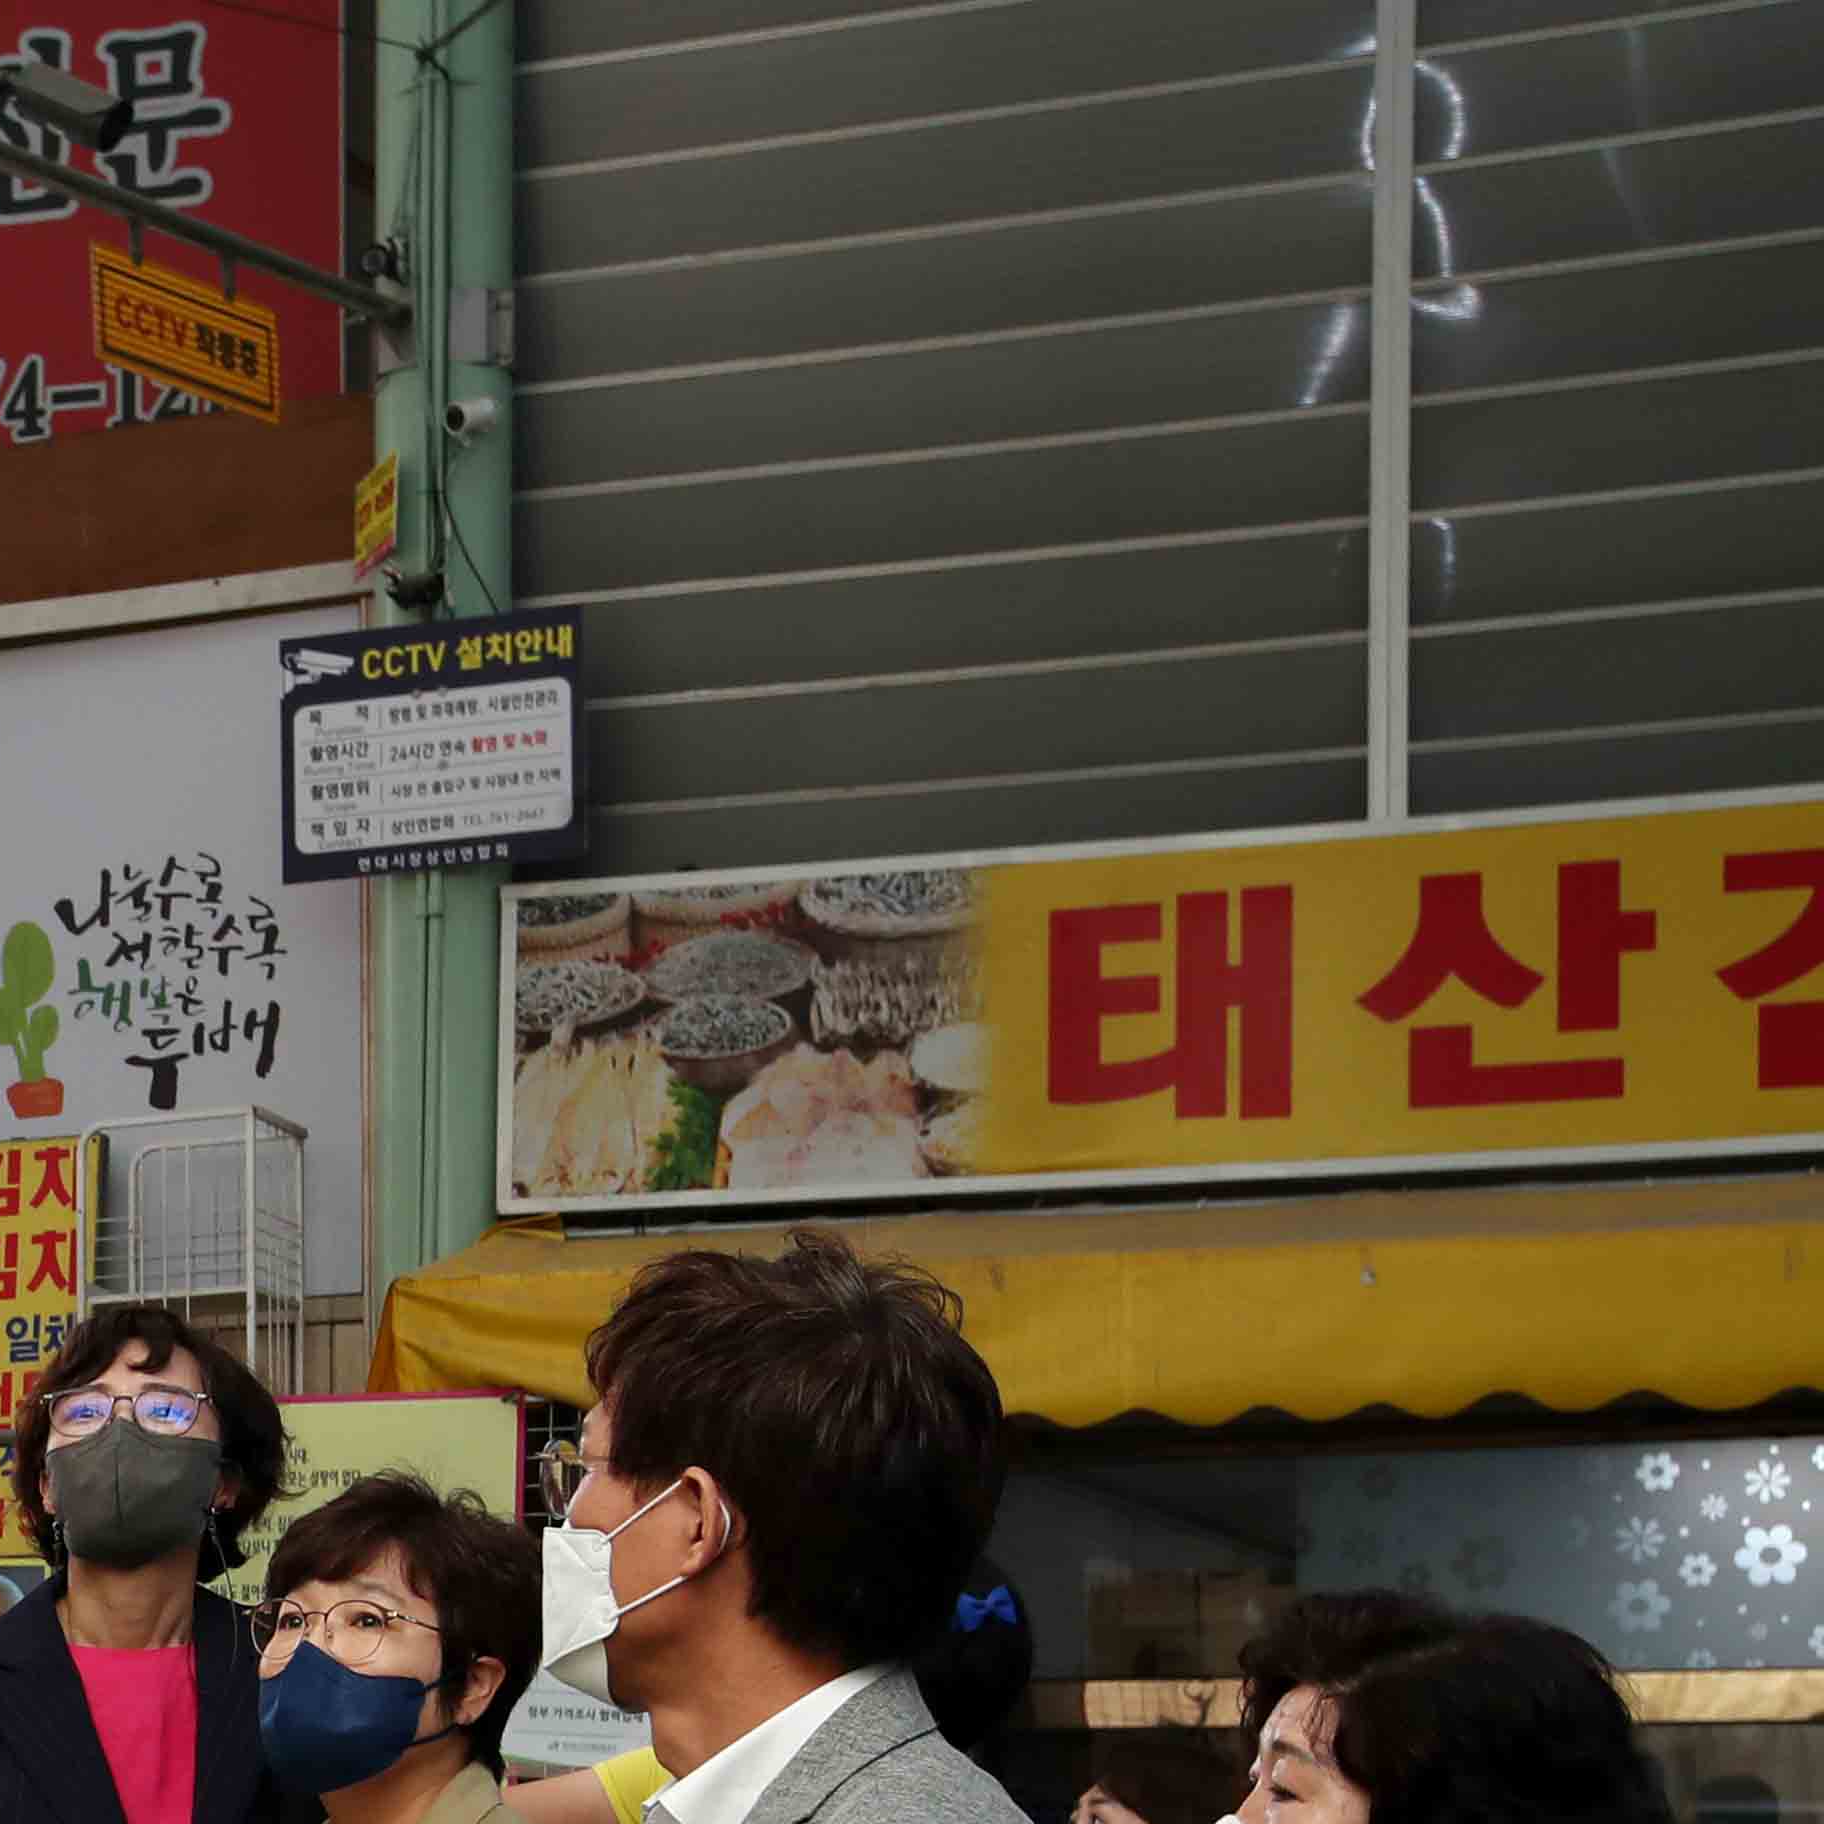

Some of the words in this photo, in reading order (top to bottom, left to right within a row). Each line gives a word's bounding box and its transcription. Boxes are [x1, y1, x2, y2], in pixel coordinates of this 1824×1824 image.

[115, 293, 186, 348] CCTV
[362, 641, 447, 680] CCTV
[456, 624, 573, 671] 설치안내
